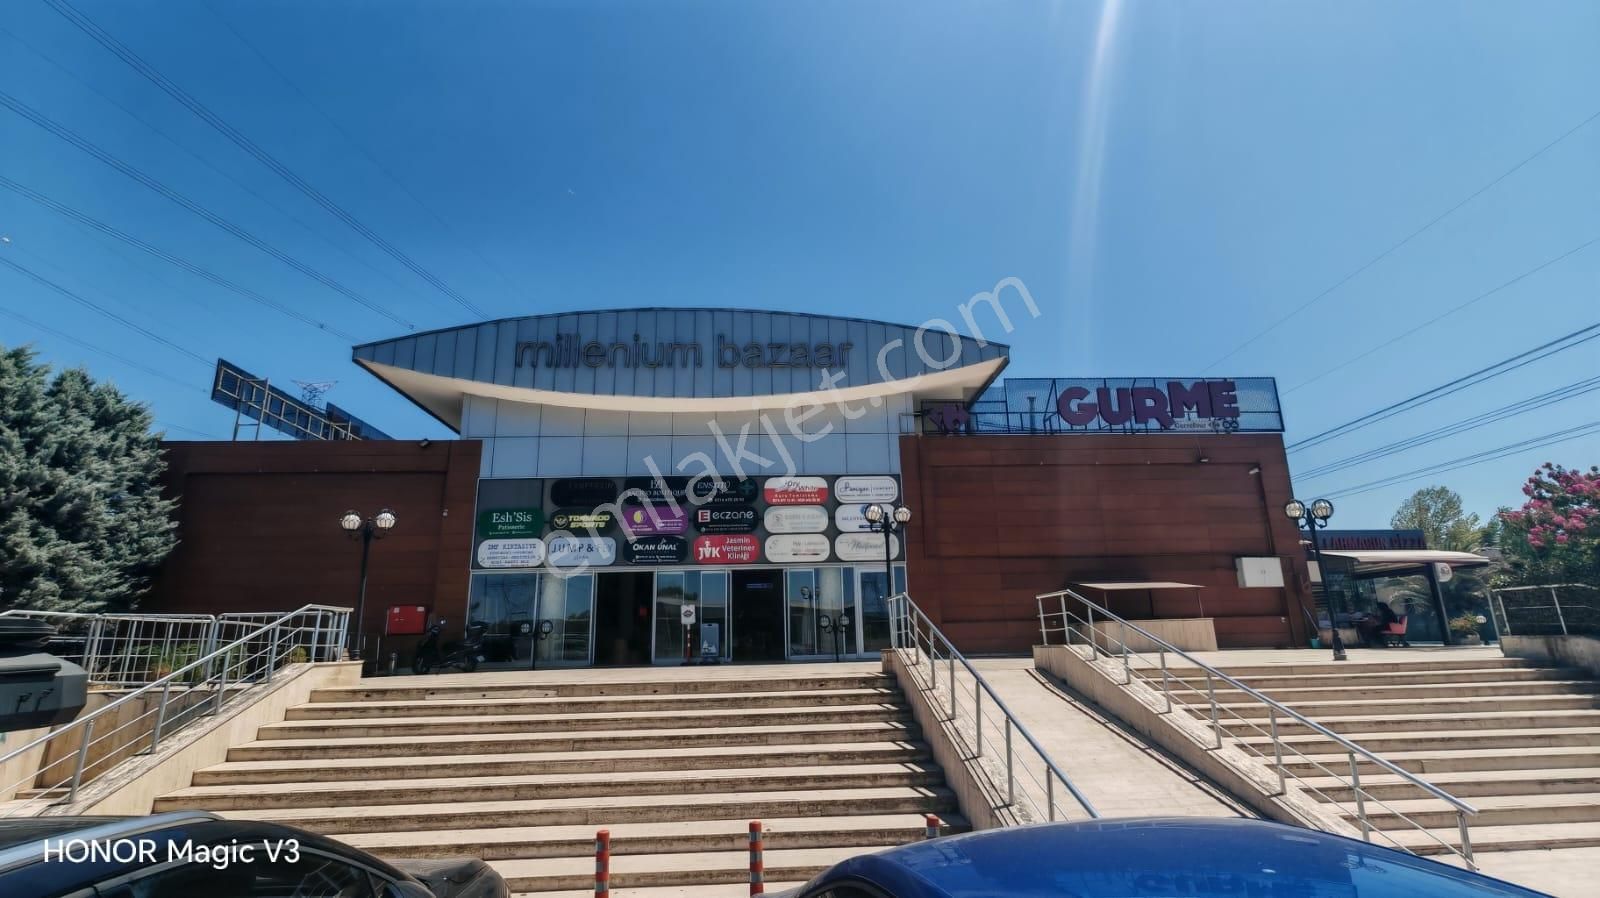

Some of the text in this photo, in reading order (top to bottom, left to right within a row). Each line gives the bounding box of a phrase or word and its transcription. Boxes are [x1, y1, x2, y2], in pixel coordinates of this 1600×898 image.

[514, 333, 855, 369] millenium bazaar
[1057, 381, 1240, 430] GURME
[492, 511, 533, 523] Esh'Sis
[712, 510, 754, 520] eczane
[551, 543, 584, 553] JUMP
[586, 544, 594, 553] &
[632, 543, 656, 551] OKAN
[698, 546, 721, 561] JVK
